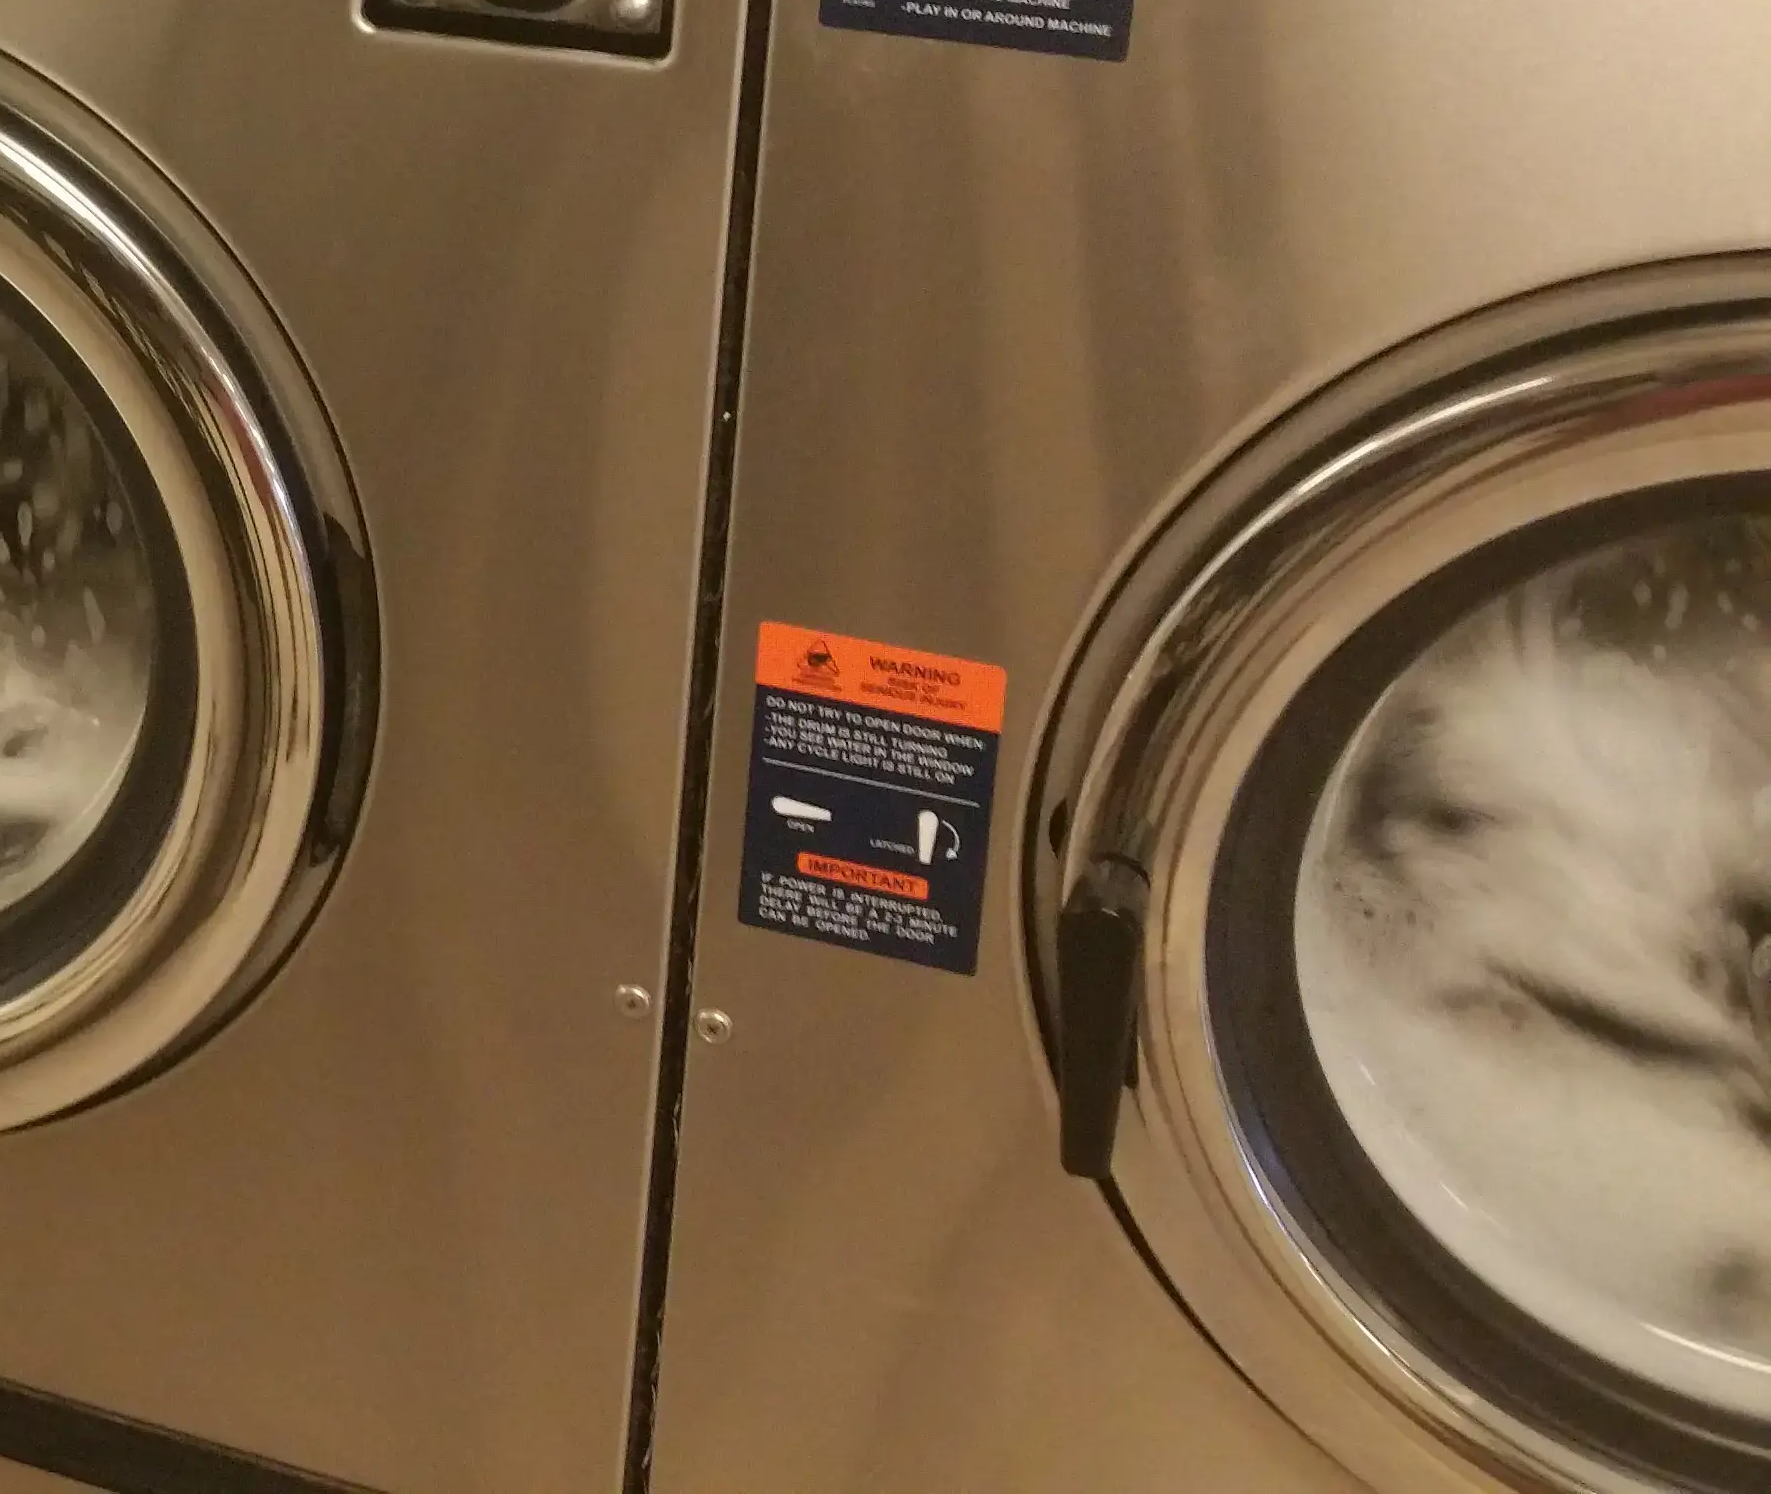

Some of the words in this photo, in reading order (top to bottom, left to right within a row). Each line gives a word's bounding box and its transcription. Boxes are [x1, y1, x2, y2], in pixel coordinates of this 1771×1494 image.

[943, 5, 959, 20] IN
[961, 8, 982, 22] OR
[984, 10, 1045, 30] AROUND
[1047, 17, 1113, 38] MACHINE
[869, 656, 961, 686] WARNING
[766, 695, 786, 709] DO
[787, 700, 815, 714] NOT
[846, 712, 862, 725] TO
[865, 716, 900, 732] OPEN
[903, 723, 941, 741] DOOR
[808, 858, 915, 894] IMPORTANT
